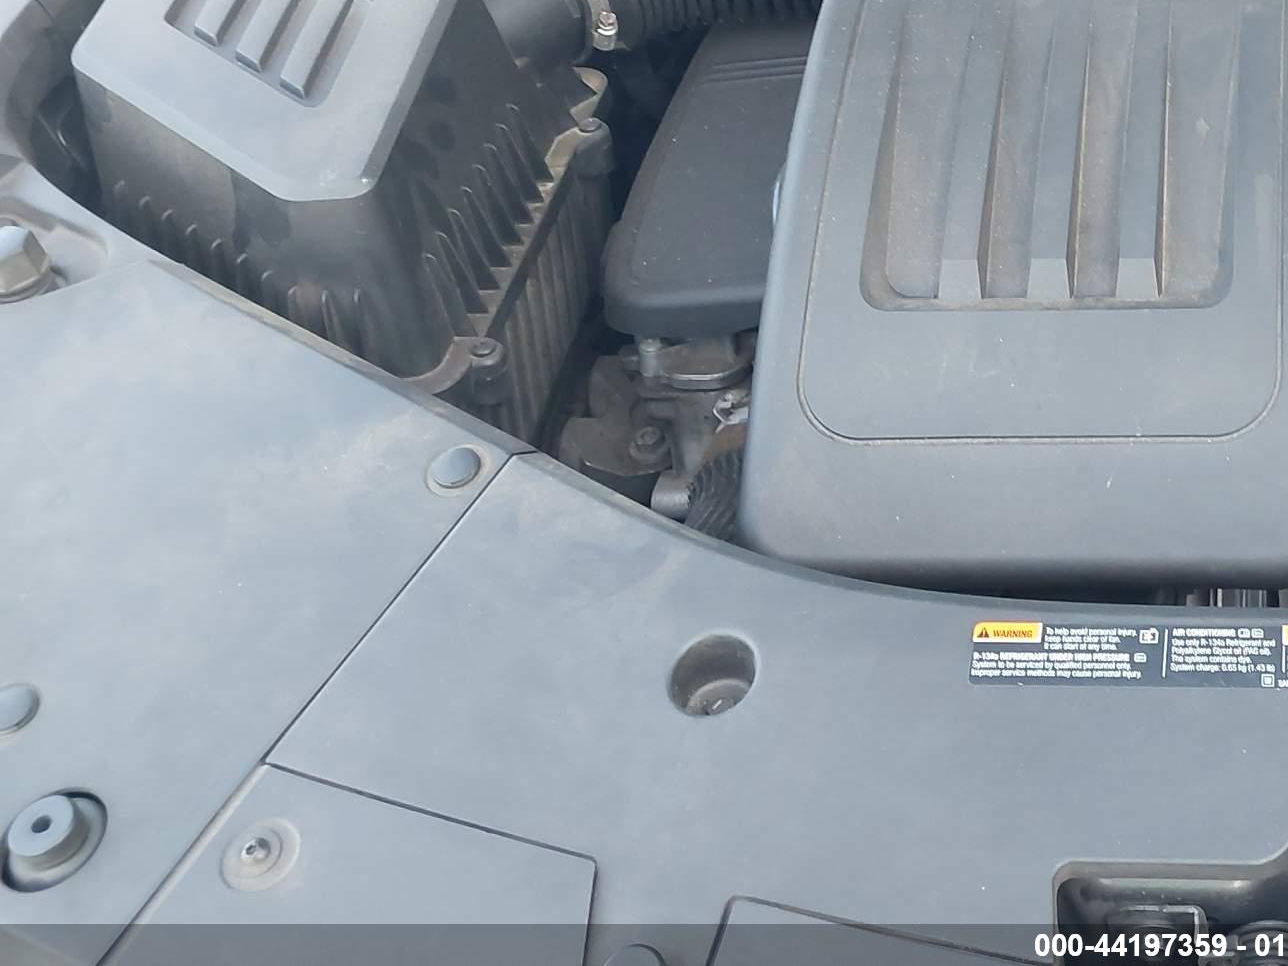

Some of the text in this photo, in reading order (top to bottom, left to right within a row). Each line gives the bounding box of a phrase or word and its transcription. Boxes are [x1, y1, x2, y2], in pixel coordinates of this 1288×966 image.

[993, 630, 1033, 638] WARNING
[1046, 627, 1054, 635] To
[1055, 627, 1069, 635] help
[1089, 628, 1116, 636] personal
[1173, 628, 1236, 637] AIR CONDITIONING
[1172, 638, 1184, 646] Use
[1185, 639, 1199, 647] only
[1263, 639, 1275, 647] and
[1213, 647, 1232, 655] Glycol
[1075, 653, 1092, 661] HIGH
[1093, 653, 1130, 661] PRESSURE
[1045, 662, 1053, 670] by
[1170, 663, 1195, 671] System
[1238, 664, 1247, 673] kg
[1248, 664, 1265, 673] (1.43
[1093, 670, 1121, 678] personal
